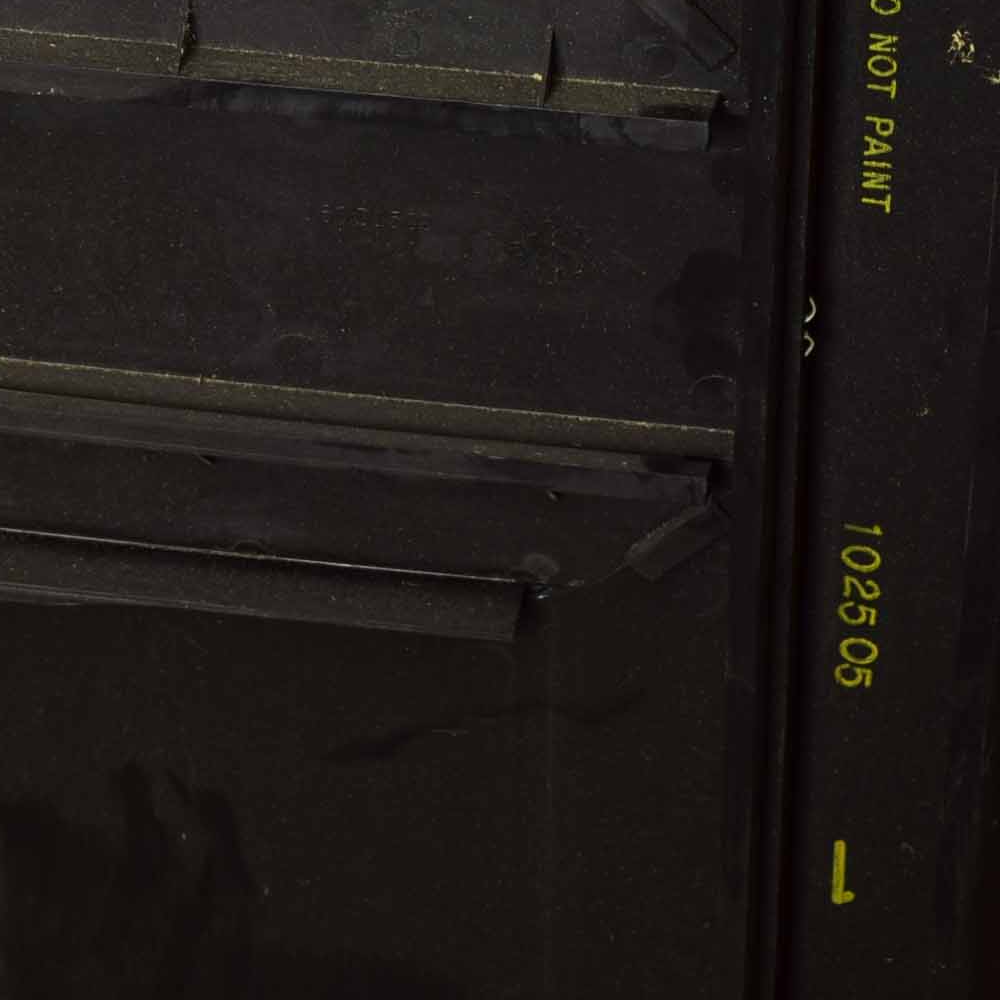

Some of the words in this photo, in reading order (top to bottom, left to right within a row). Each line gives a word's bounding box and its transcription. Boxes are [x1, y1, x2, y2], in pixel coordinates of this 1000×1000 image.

[866, 32, 900, 101] NOT
[860, 114, 896, 215] PAINT
[831, 839, 856, 905] 1
